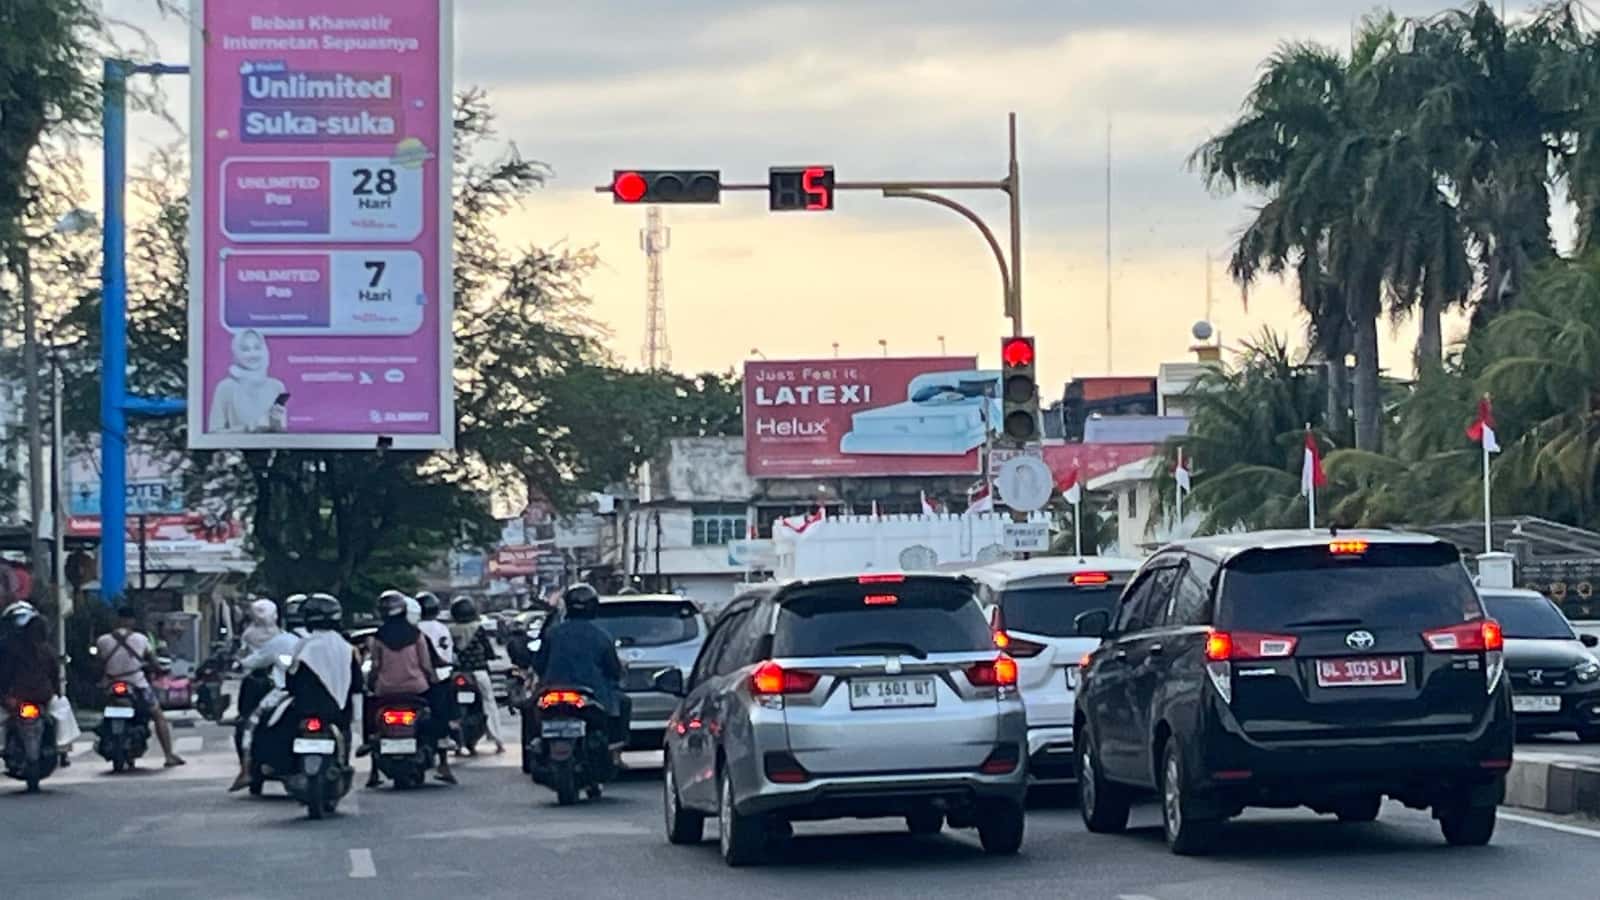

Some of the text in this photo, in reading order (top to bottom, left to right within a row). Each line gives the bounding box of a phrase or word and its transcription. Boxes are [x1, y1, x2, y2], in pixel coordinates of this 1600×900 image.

[251, 15, 392, 30] Bebas Khawatir
[223, 36, 419, 53] Internetan Sepuasnya
[248, 74, 392, 98] Unlimited
[246, 111, 395, 135] Suka-suka
[237, 176, 320, 189] UNLIMITED
[352, 168, 398, 196] 28
[803, 168, 827, 210] 5
[358, 197, 392, 209] Hari
[237, 269, 320, 282] UNLIMITED
[364, 261, 386, 287] 7
[358, 289, 392, 301] Hari
[802, 367, 837, 380] Feel
[755, 384, 871, 405] LATEX!
[756, 417, 828, 435] Helux
